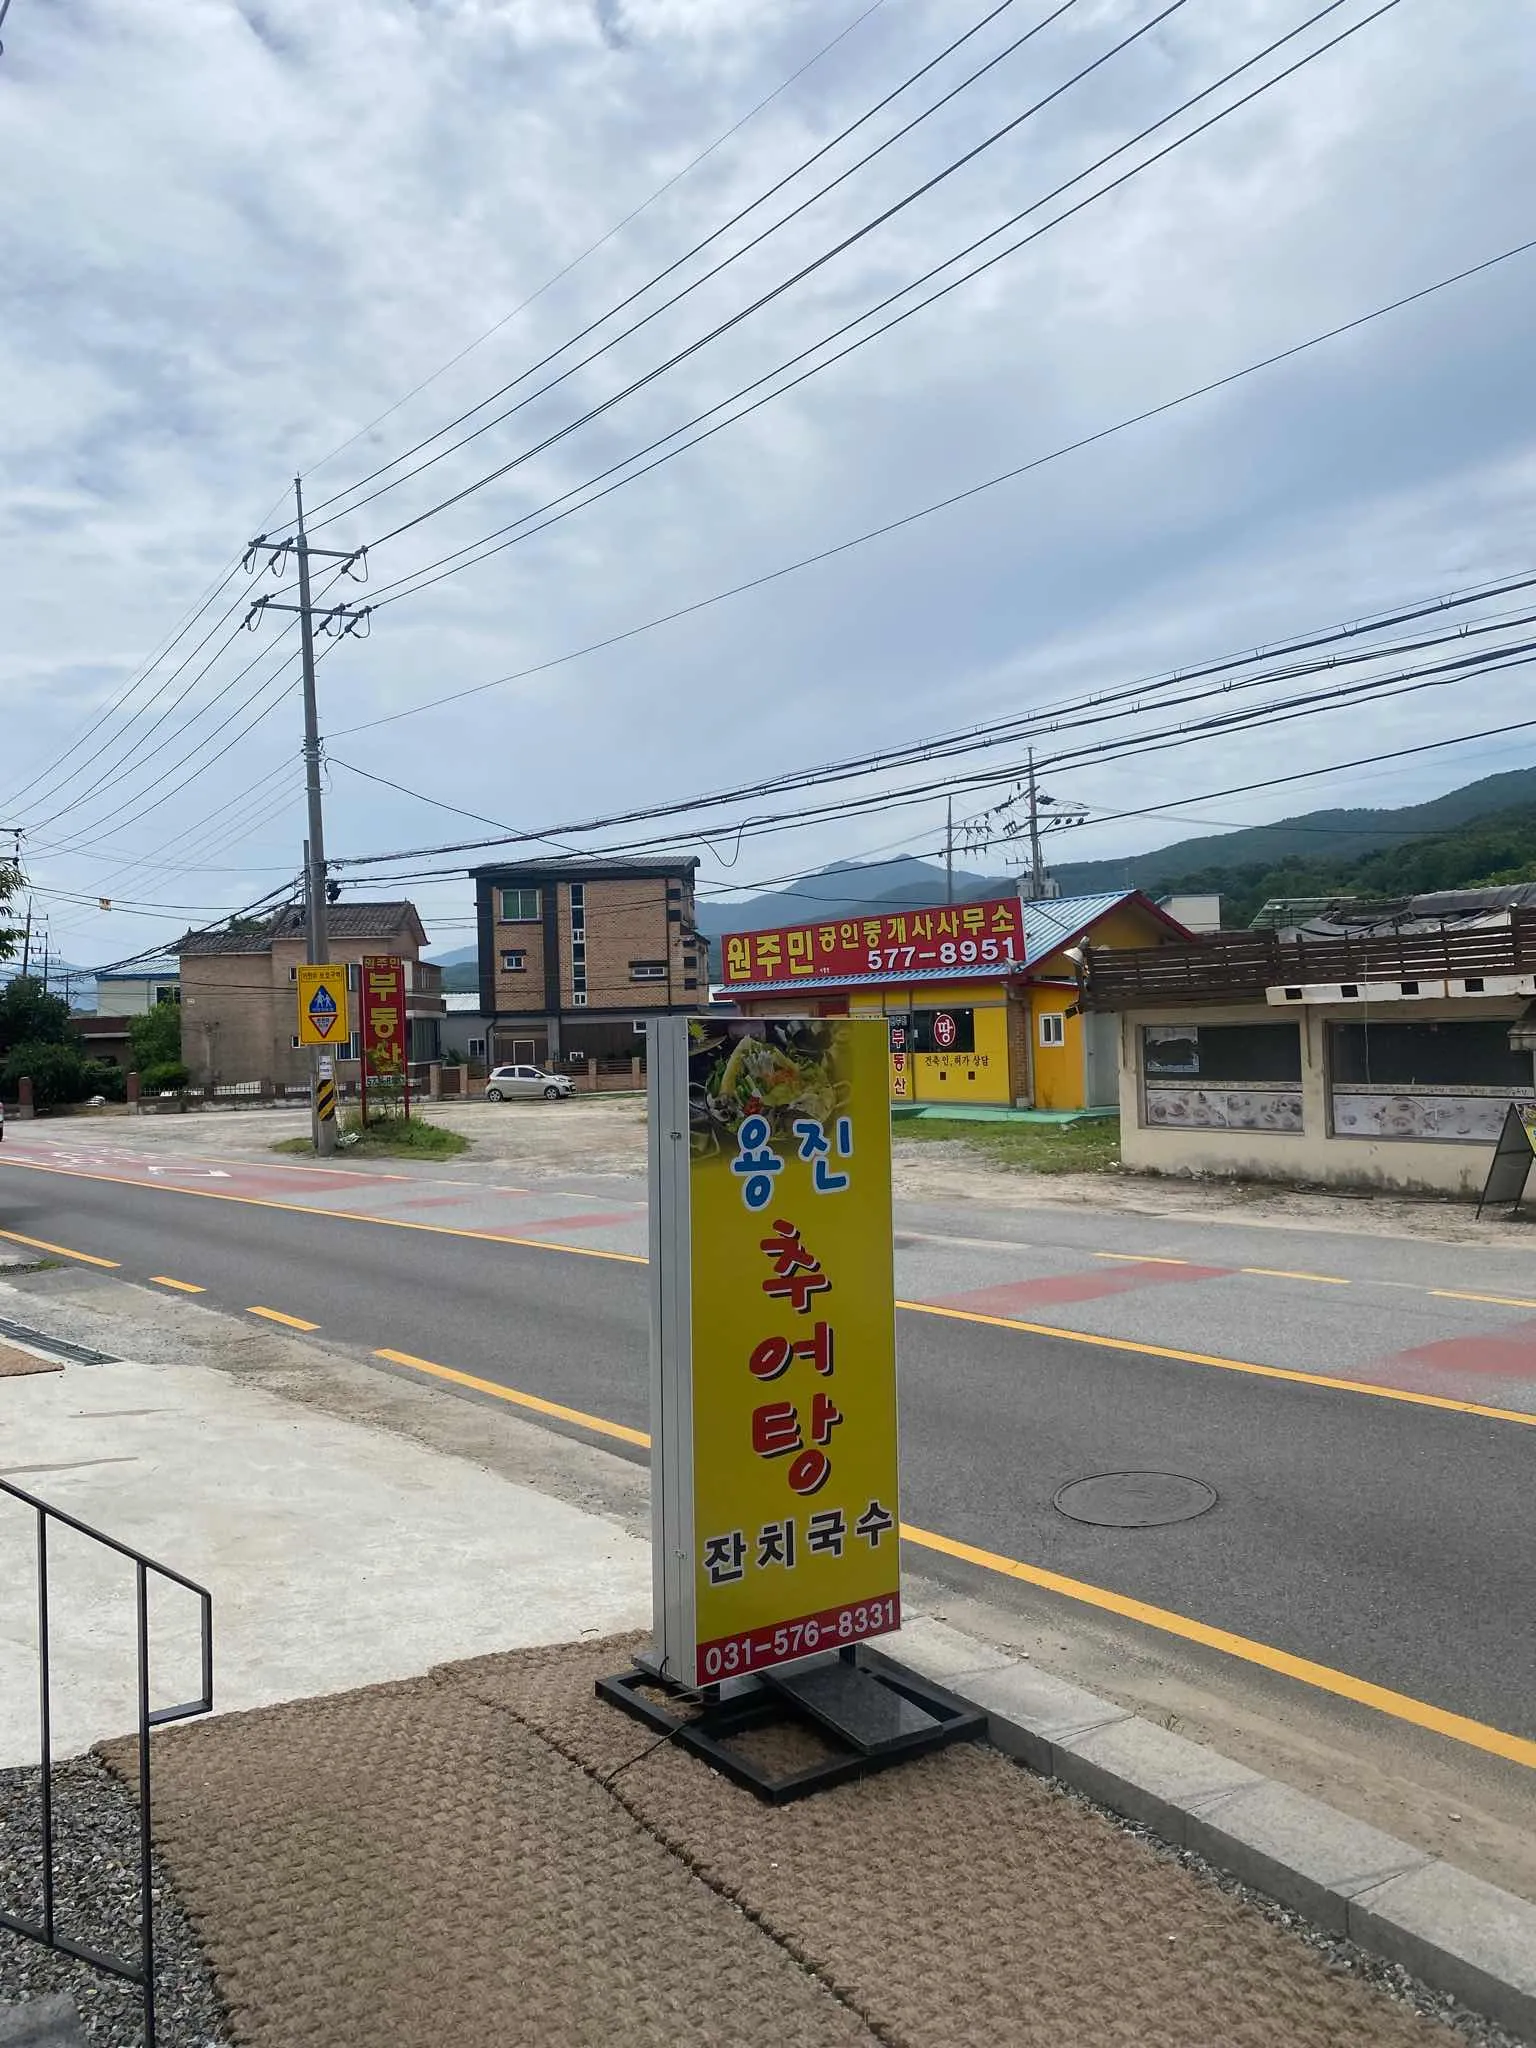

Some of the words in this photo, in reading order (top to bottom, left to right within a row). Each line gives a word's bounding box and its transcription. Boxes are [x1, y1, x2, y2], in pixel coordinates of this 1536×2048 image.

[365, 957, 400, 969] 원주민
[727, 929, 815, 980] 원주민
[818, 904, 1016, 953] 공인중개사사무소
[867, 936, 1016, 970] 577-8951
[369, 972, 402, 1073] 부동산
[937, 1019, 953, 1043] 땅
[891, 1029, 906, 1096] 부동산
[731, 1116, 853, 1209] 용진
[750, 1219, 843, 1495] 추어탕
[704, 1500, 893, 1587] 잔치국수
[704, 1599, 895, 1676] 031-576-8331
